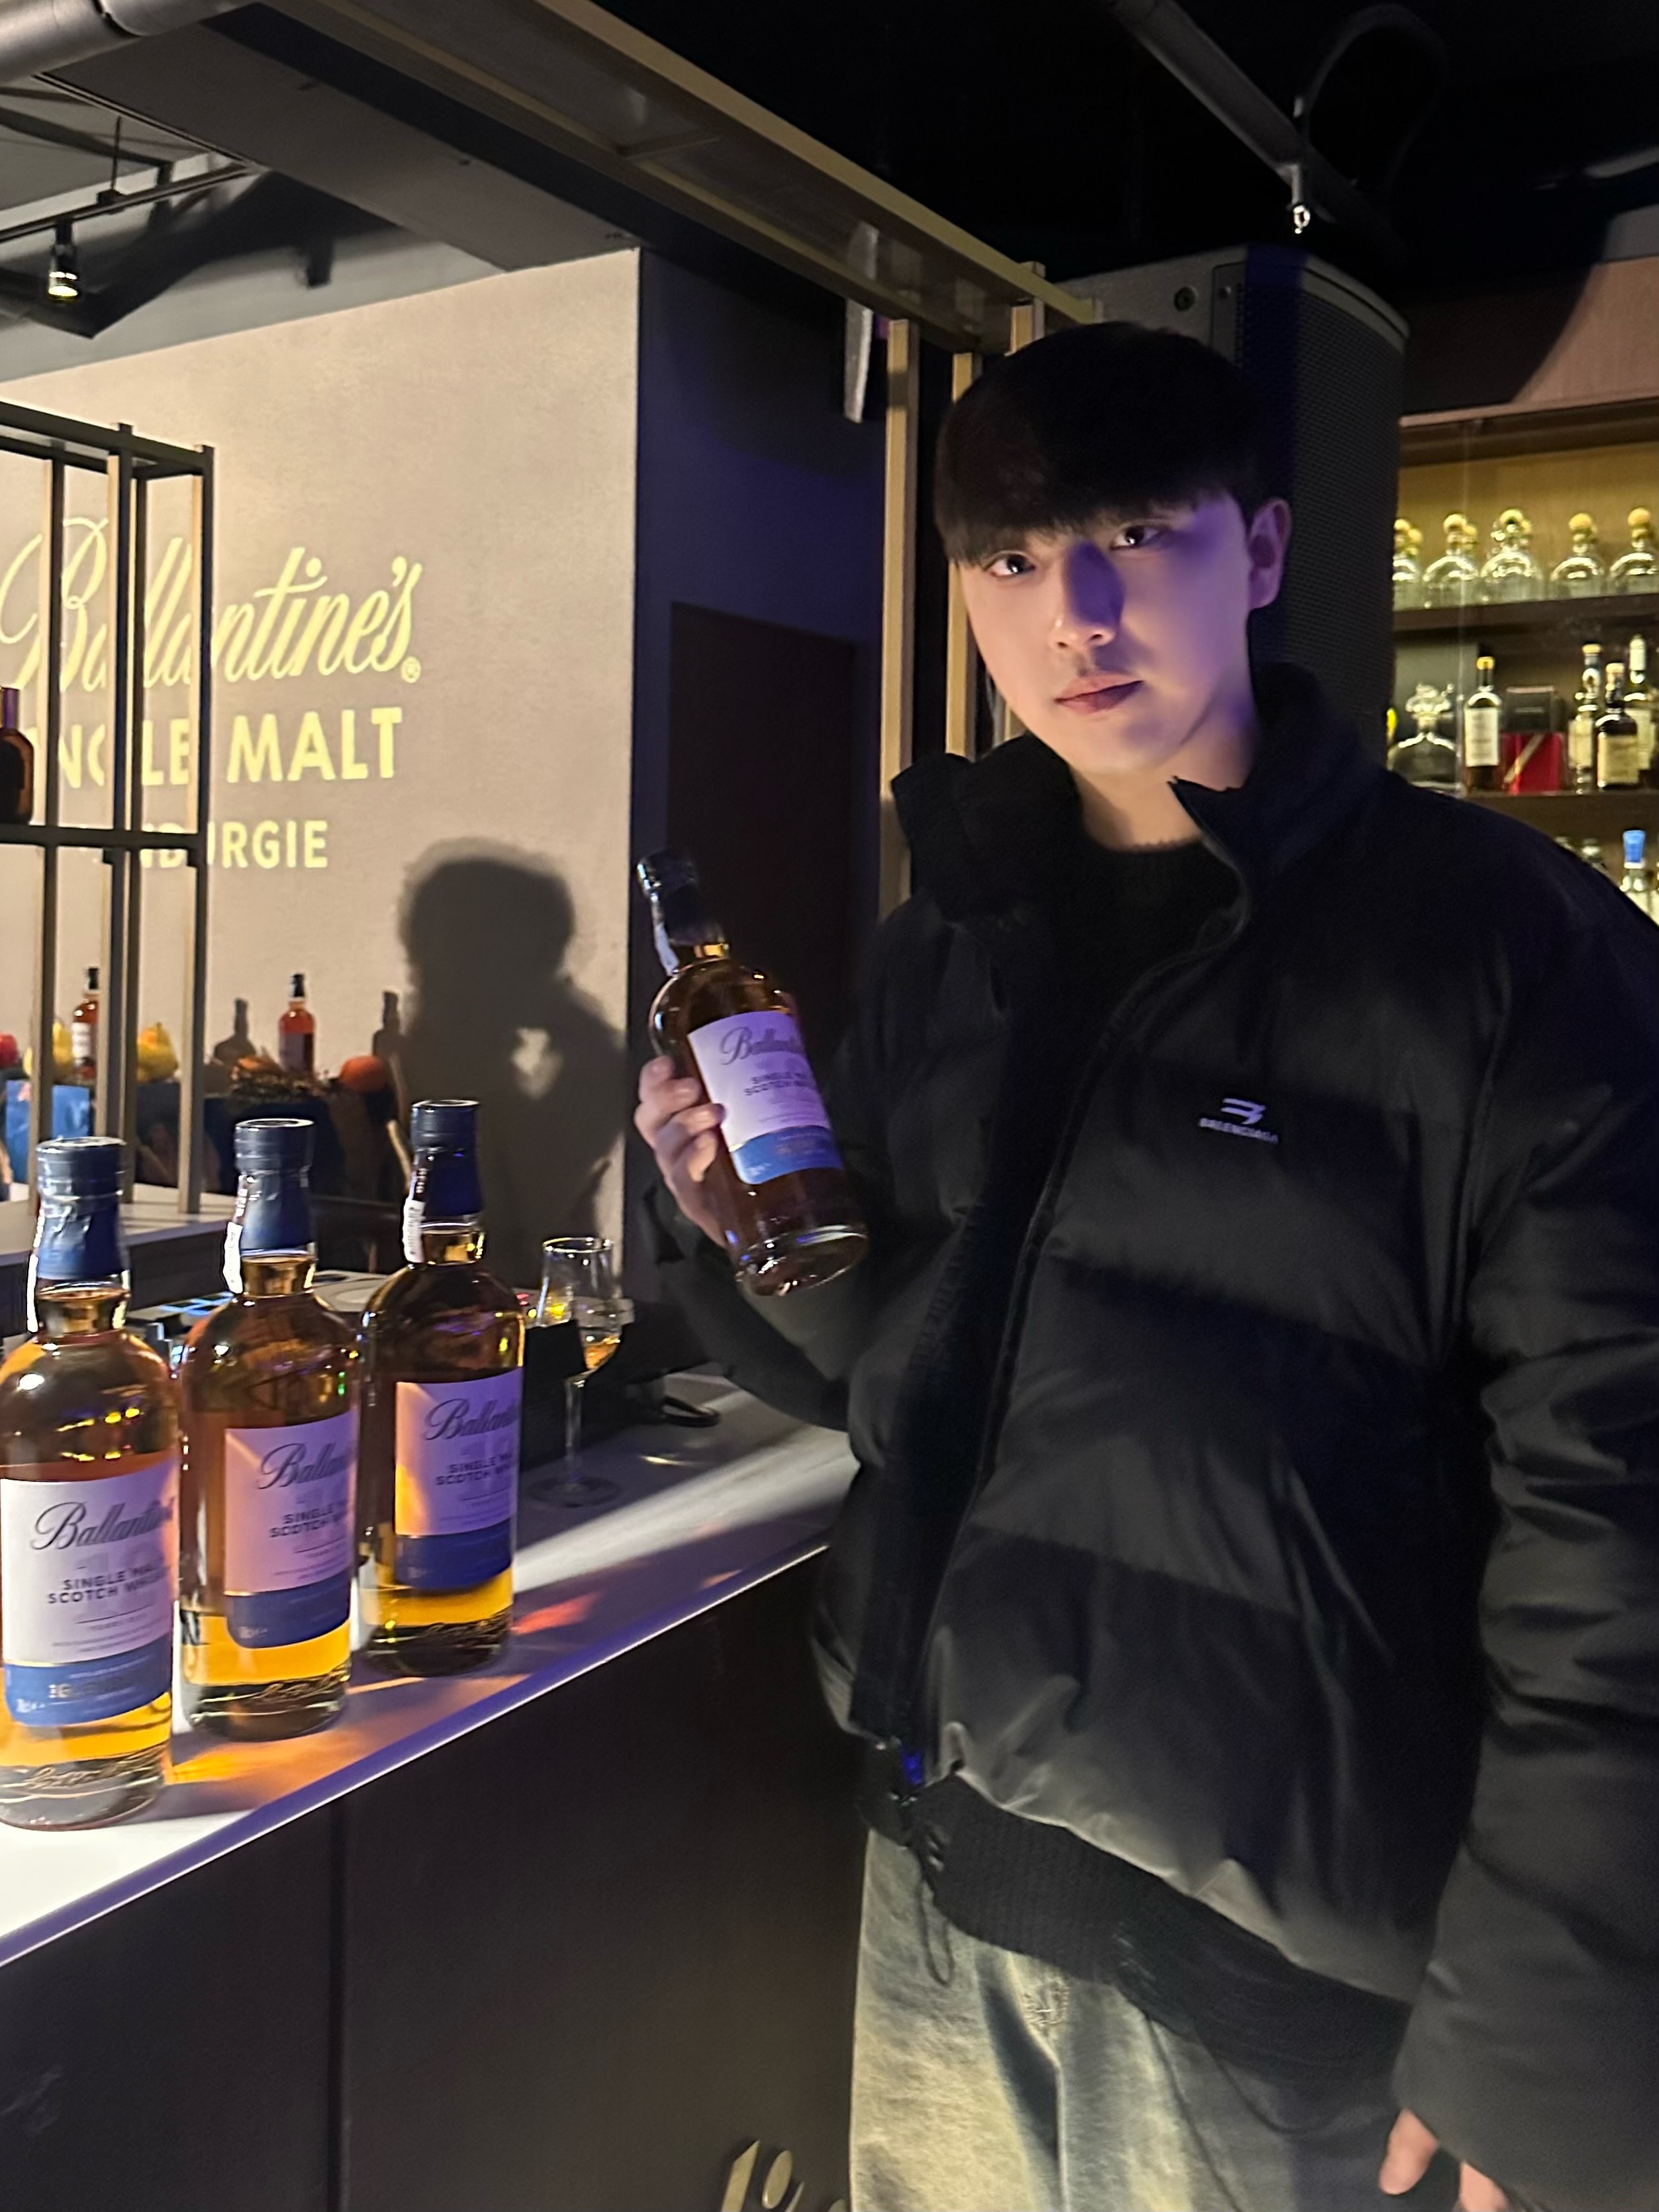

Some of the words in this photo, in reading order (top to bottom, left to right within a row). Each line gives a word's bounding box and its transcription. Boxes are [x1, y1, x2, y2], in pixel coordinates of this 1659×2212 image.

[226, 706, 403, 783] MALT
[63, 1570, 126, 1591] SINGLE
[47, 1587, 118, 1605] SCOTCH
